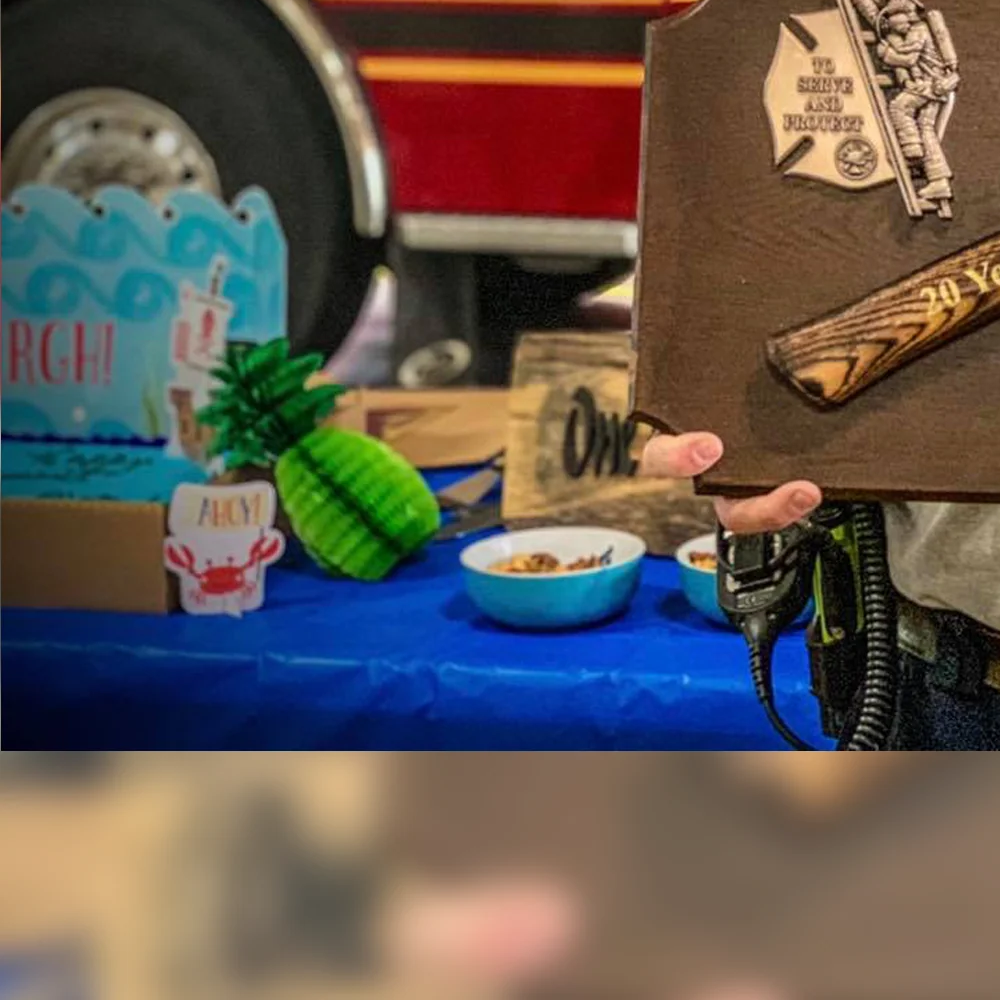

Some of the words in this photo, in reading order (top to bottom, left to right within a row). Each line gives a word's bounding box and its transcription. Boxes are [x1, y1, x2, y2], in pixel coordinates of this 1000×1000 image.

[811, 56, 836, 74] TO
[797, 75, 854, 94] SERVE
[804, 95, 844, 113] AND
[783, 113, 865, 133] PROTECT
[919, 277, 961, 317] 20
